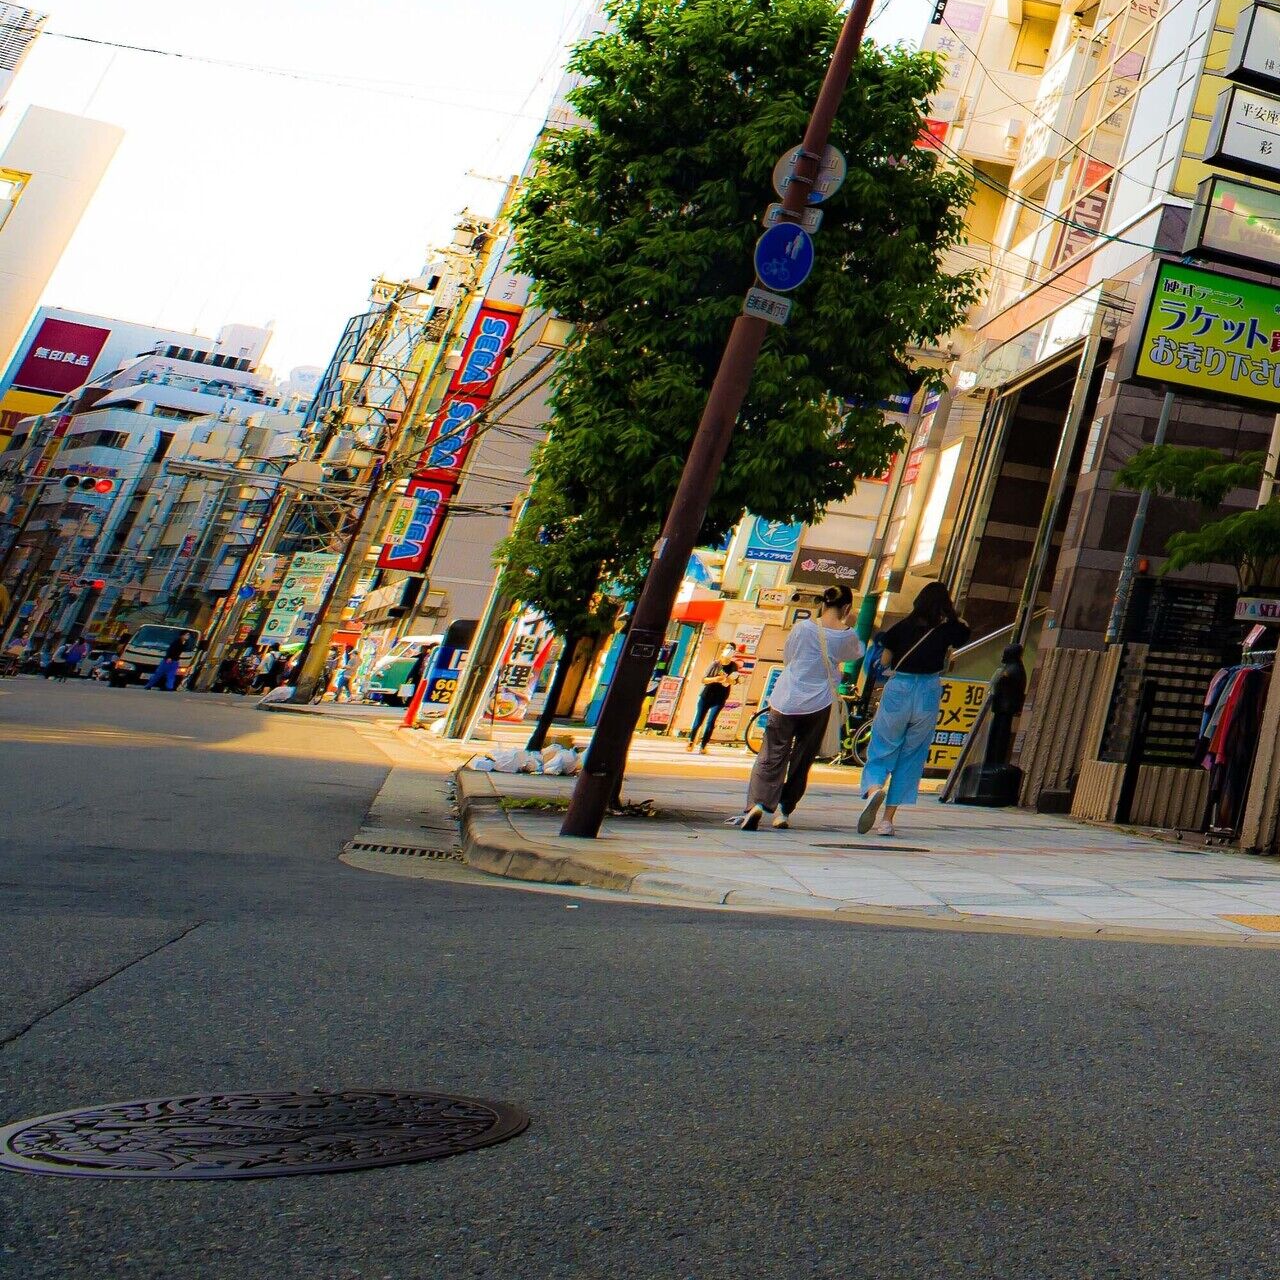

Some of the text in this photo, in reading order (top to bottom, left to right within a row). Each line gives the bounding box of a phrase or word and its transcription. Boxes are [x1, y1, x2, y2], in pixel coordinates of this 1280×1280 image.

[1162, 277, 1245, 310] 硬式テニス
[33, 346, 91, 367] 無印良品
[460, 317, 509, 385] SEGA
[430, 400, 478, 469] SEGA
[389, 486, 443, 561] SEGA
